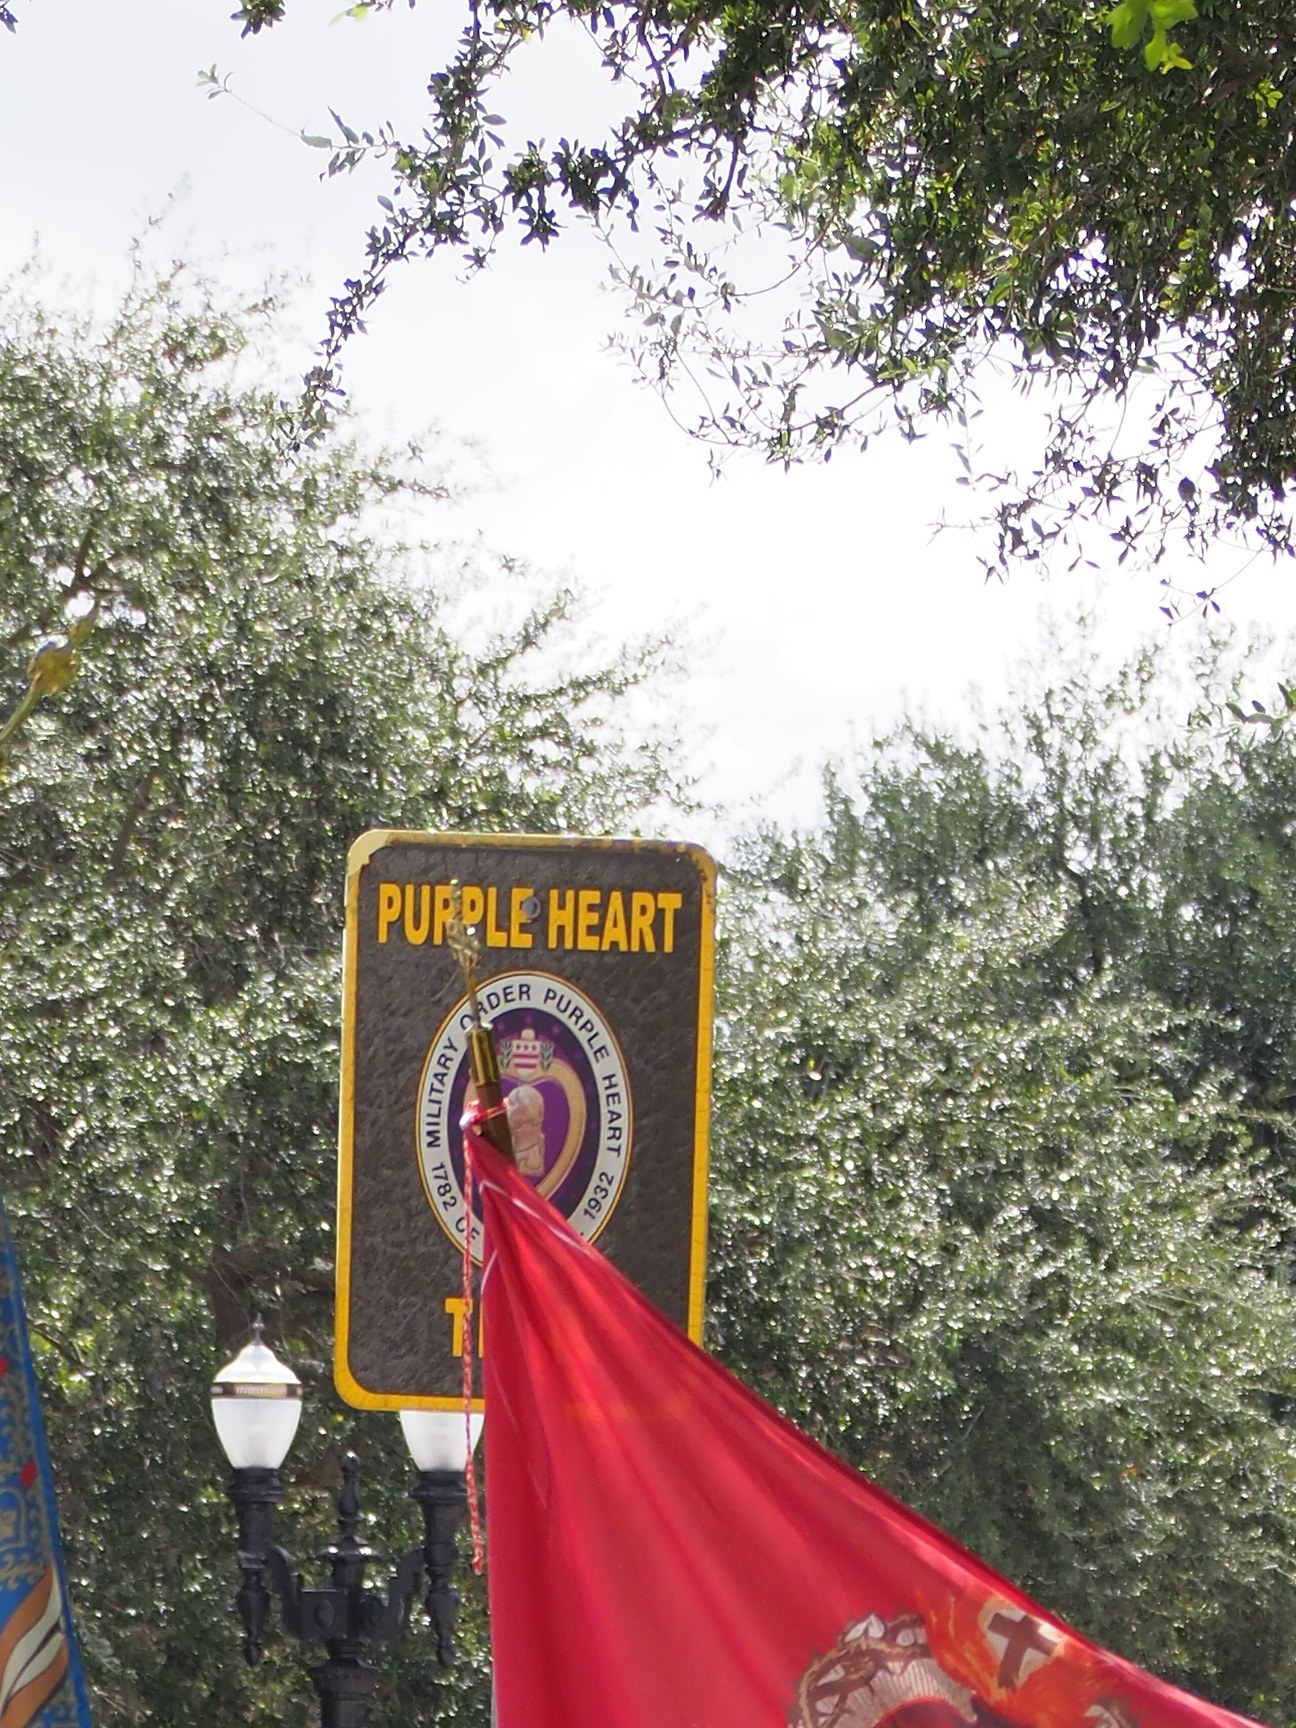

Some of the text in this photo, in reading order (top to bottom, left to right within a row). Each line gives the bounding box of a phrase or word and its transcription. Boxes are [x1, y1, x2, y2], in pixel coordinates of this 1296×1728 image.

[377, 882, 683, 954] PURPLE HEART
[425, 982, 624, 1159] MILITARY ORDER PURPLE HEART
[430, 1161, 459, 1213] 1782
[582, 1170, 616, 1221] 1932
